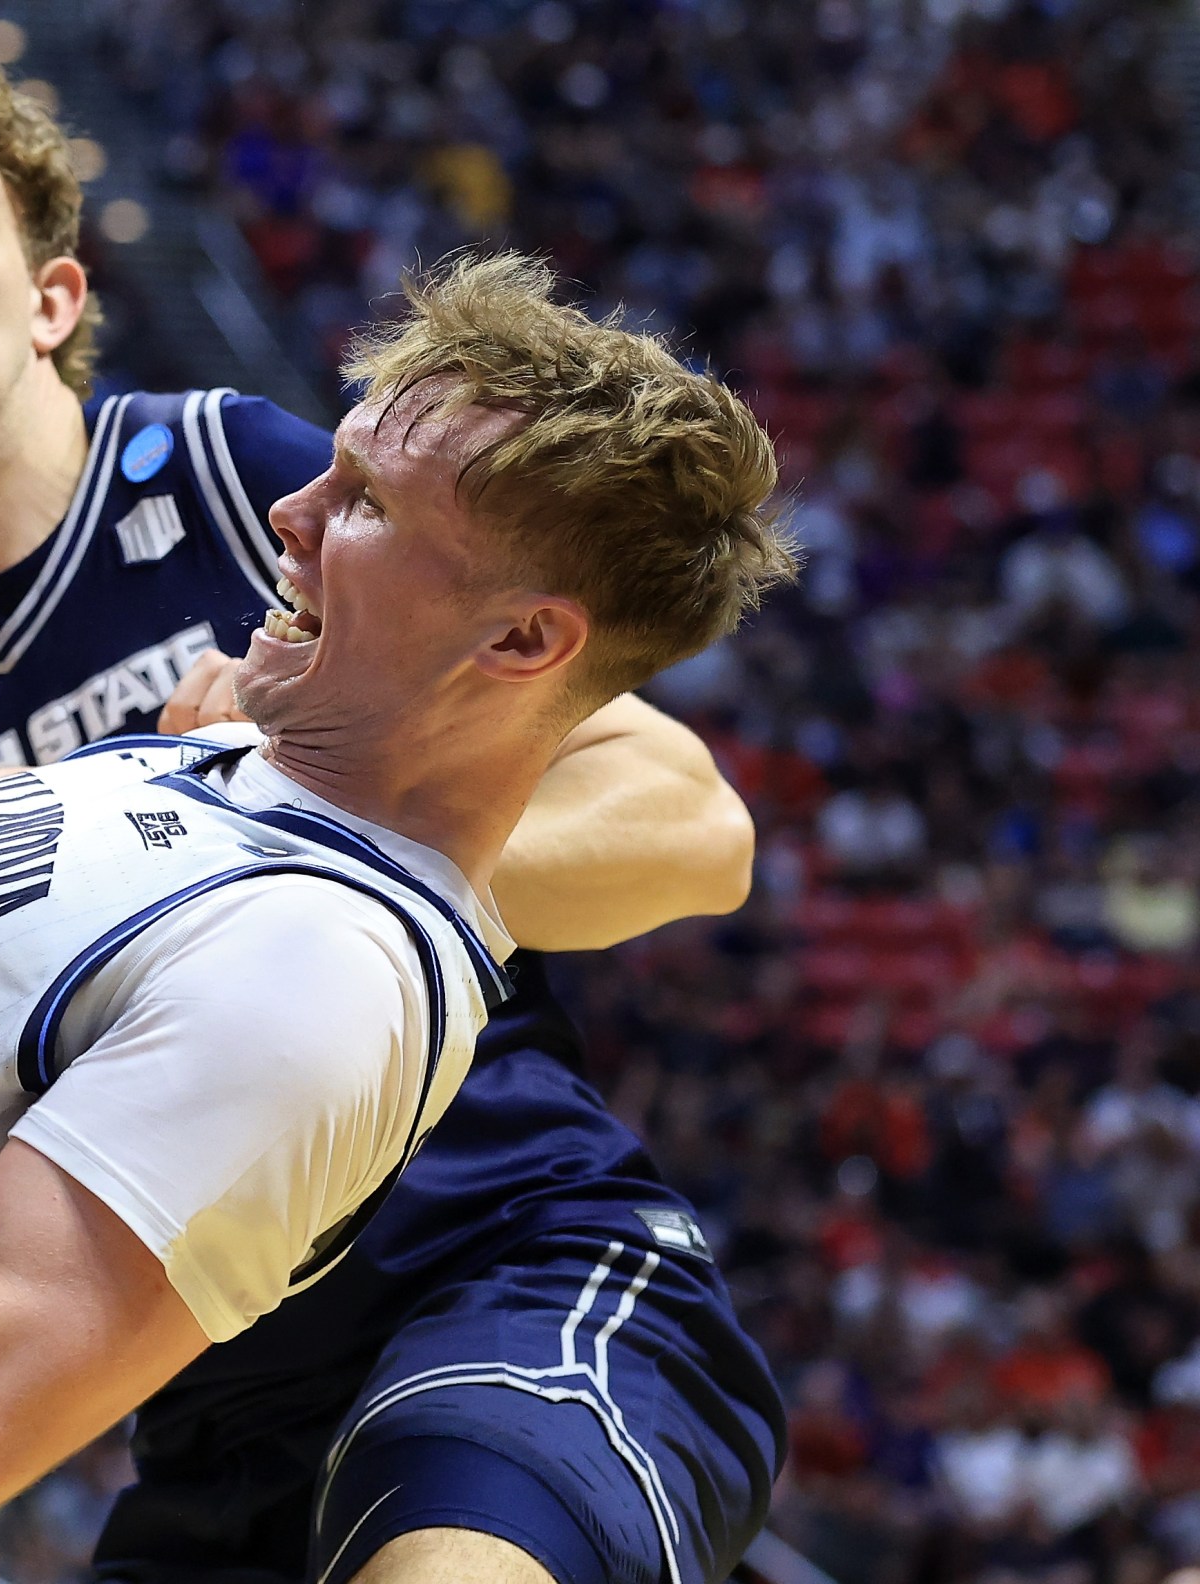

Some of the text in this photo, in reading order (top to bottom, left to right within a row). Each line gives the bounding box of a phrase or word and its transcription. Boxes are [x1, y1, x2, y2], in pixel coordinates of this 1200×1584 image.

[26, 620, 219, 767] STATE
[136, 813, 172, 849] EAST
[156, 810, 188, 836] BIG
